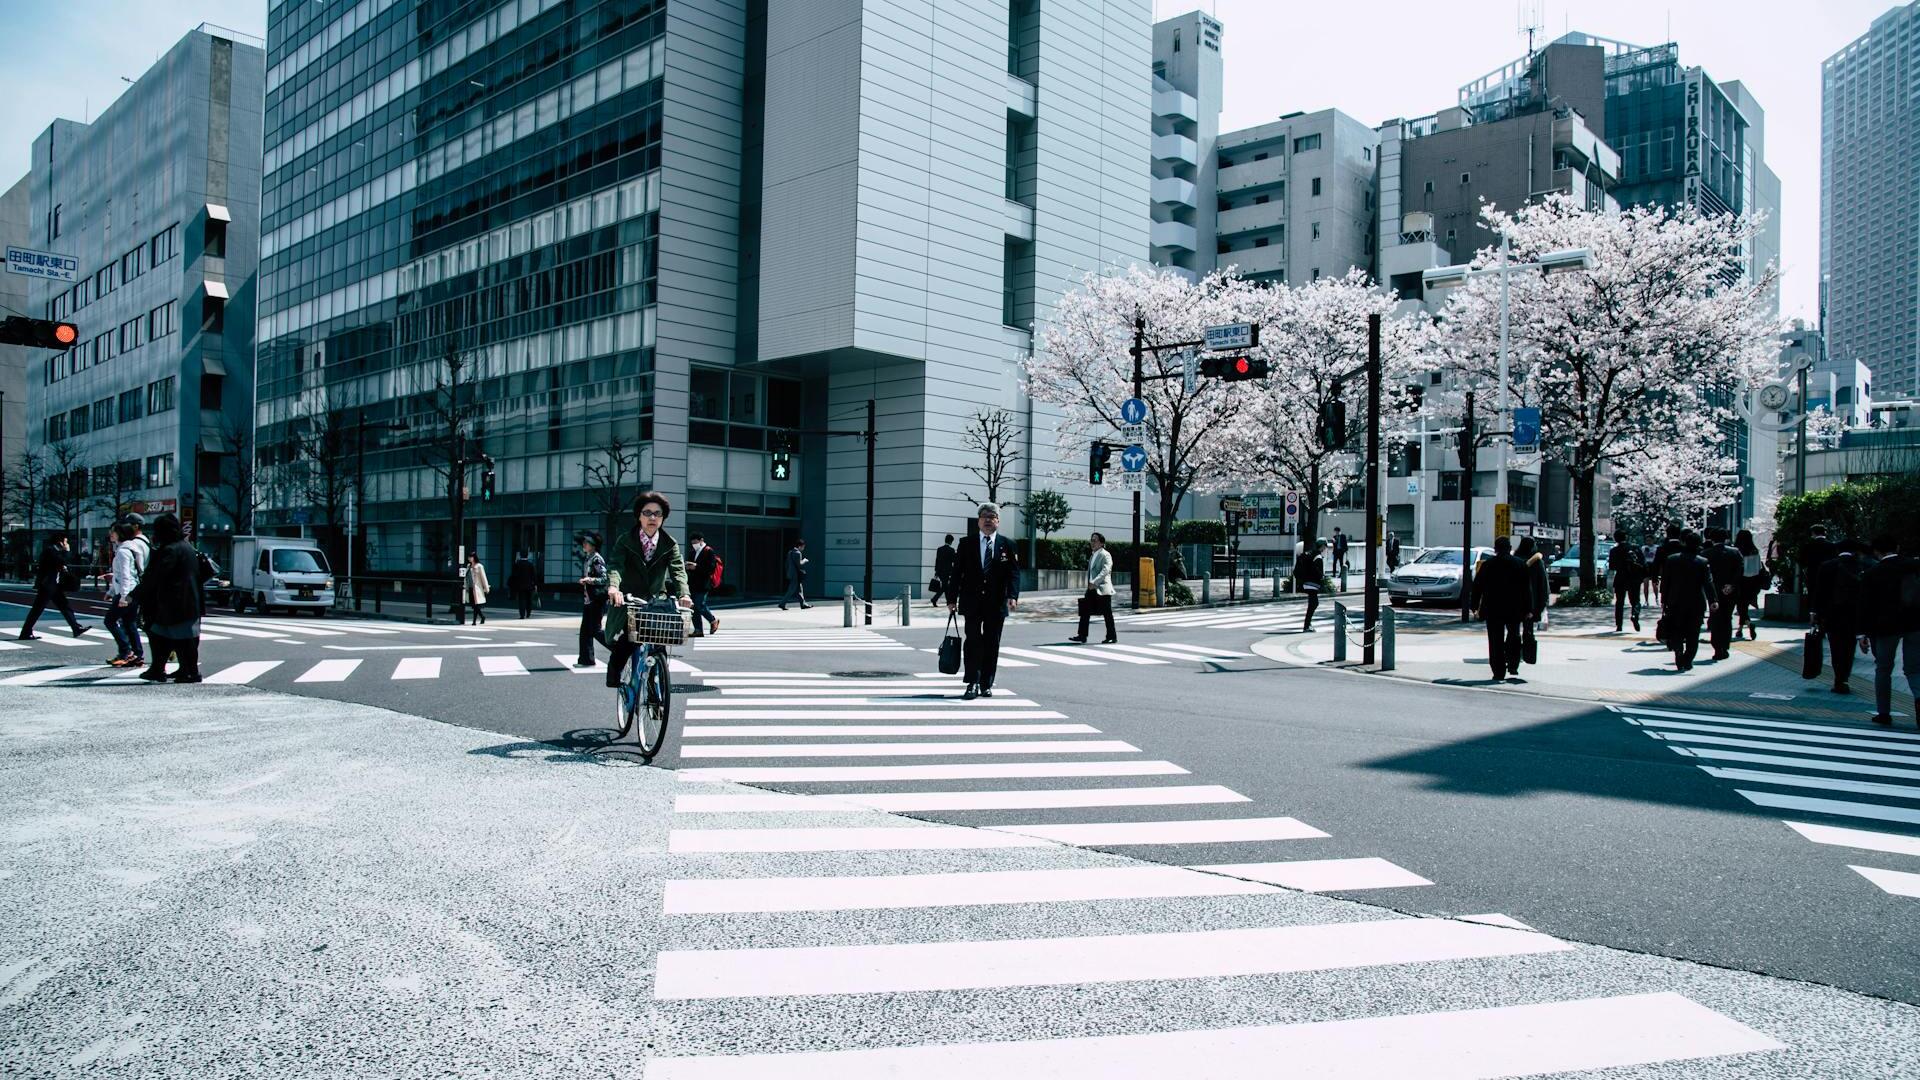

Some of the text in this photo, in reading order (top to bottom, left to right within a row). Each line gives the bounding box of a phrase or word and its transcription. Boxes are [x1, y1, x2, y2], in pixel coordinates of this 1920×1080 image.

[1687, 82, 1699, 173] SHIBAURA
[9, 250, 76, 271] 田町駅東口
[13, 264, 44, 274] Tamachi
[1207, 326, 1248, 339] 田町駅東口
